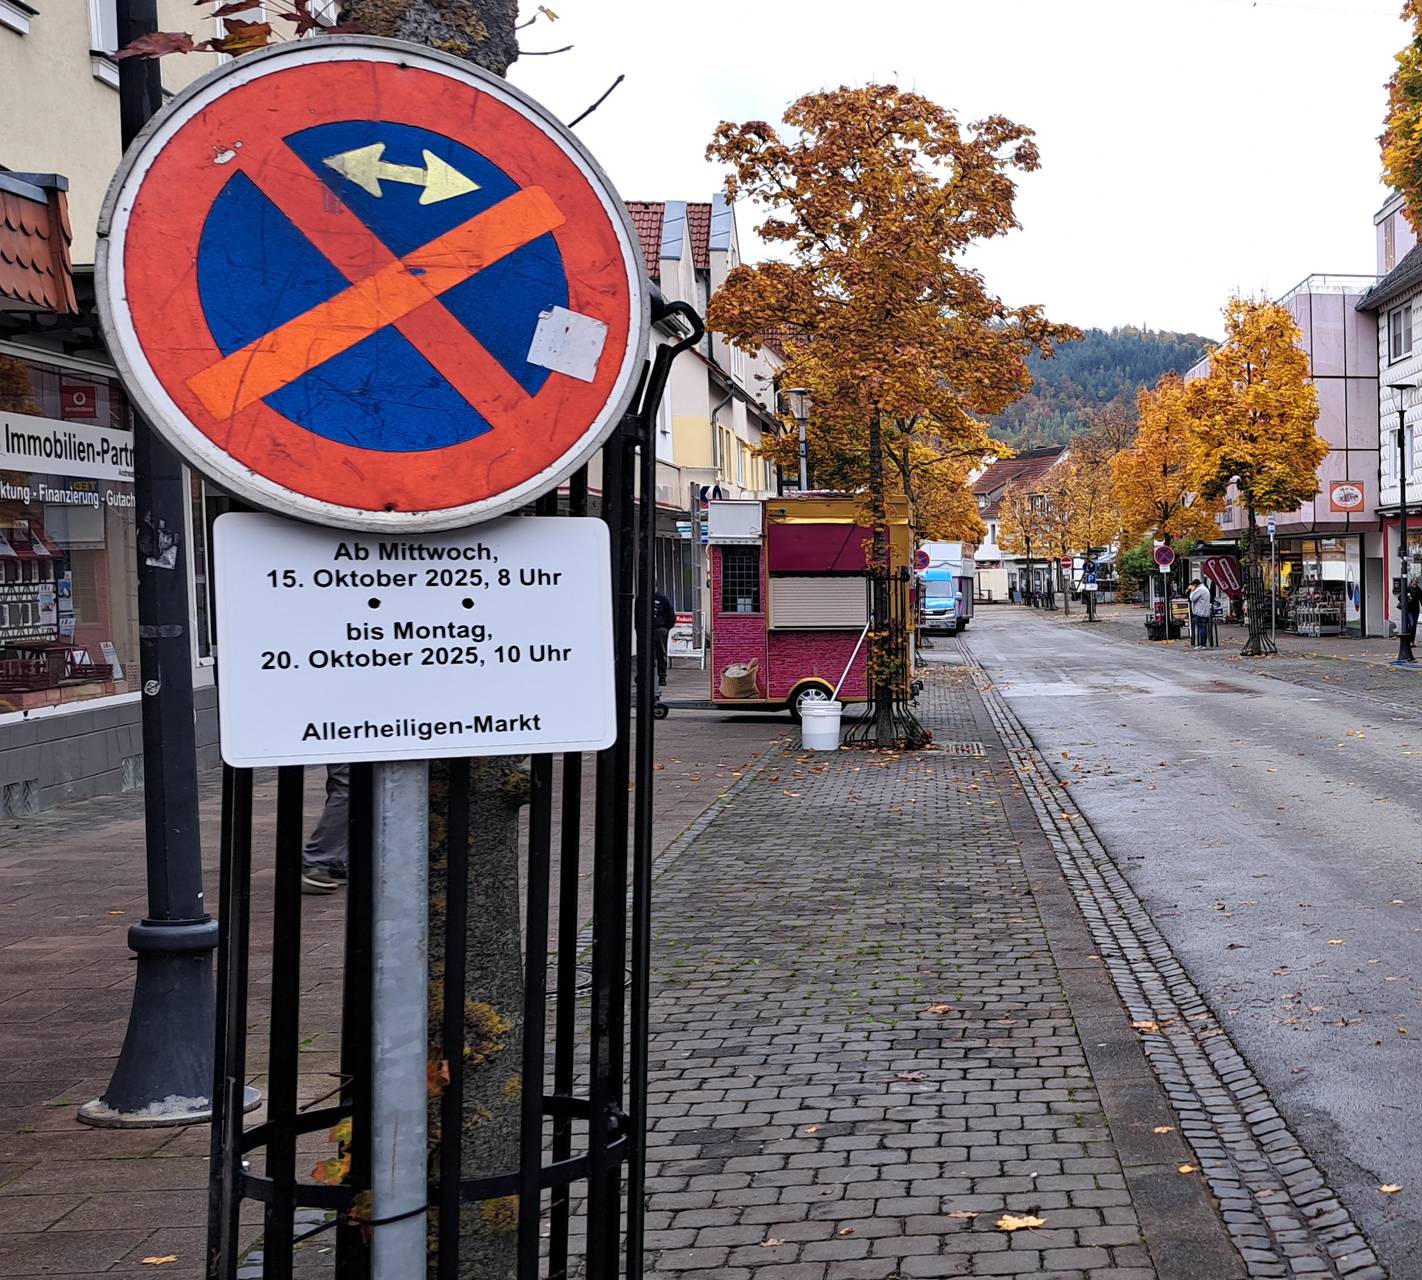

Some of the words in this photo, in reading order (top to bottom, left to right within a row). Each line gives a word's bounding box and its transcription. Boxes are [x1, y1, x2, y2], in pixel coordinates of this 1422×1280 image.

[38, 483, 99, 509] Finanzierung
[334, 542, 370, 561] Ab
[378, 542, 498, 564] Mittwoch,
[267, 569, 304, 588] 15.
[313, 568, 417, 588] Oktober
[425, 568, 490, 590] 2025,
[497, 568, 511, 587] 8
[519, 568, 562, 587] Uhr
[346, 622, 384, 641] bis
[393, 621, 493, 643] Montag,
[261, 651, 299, 670] 20.
[308, 648, 412, 669] Oktober
[420, 646, 486, 668] 2025,
[494, 645, 521, 664] 10
[529, 644, 572, 663] Uhr
[301, 714, 542, 742] Allerheiligen-Markt
